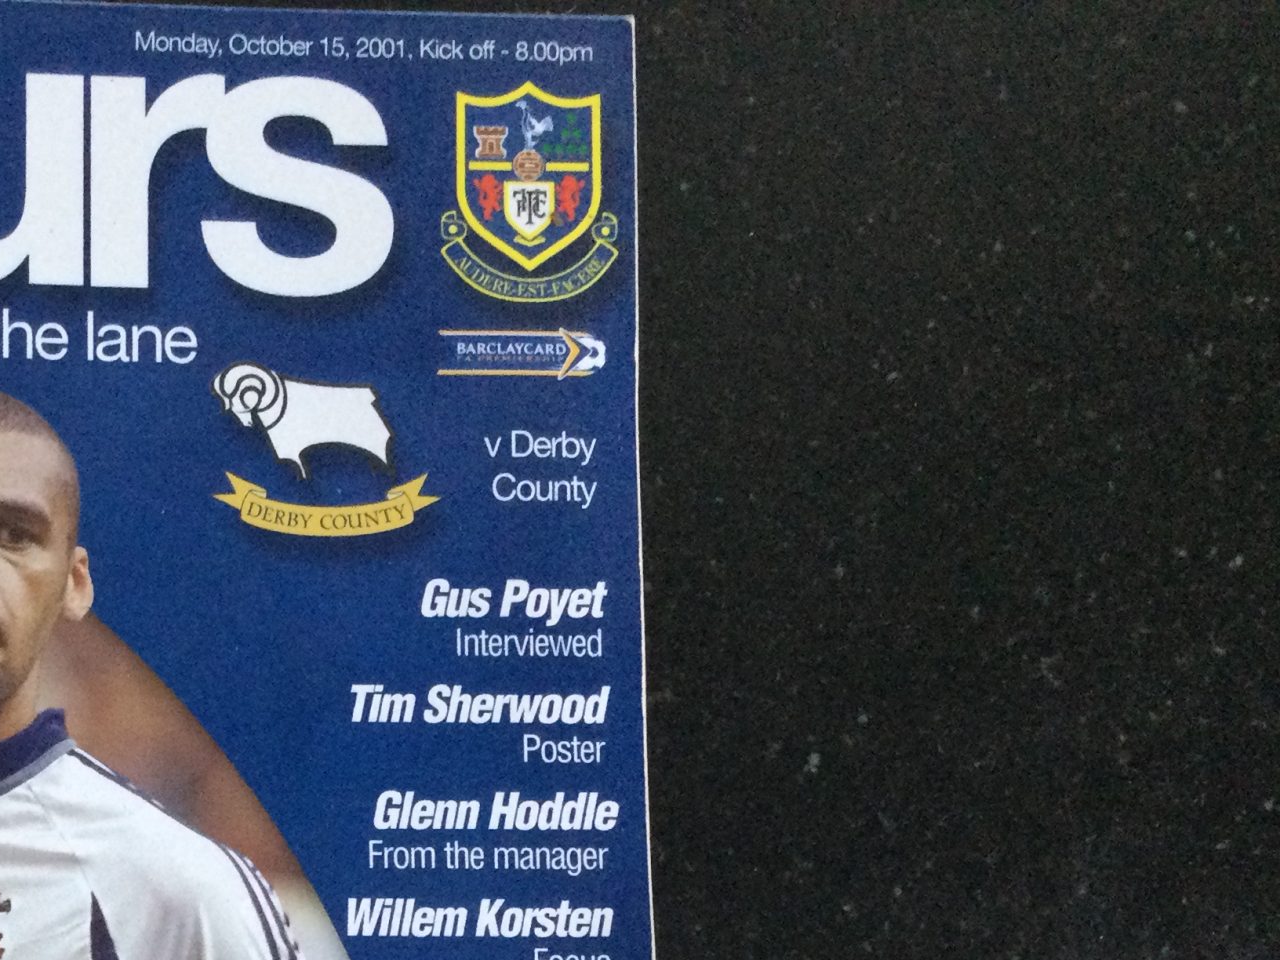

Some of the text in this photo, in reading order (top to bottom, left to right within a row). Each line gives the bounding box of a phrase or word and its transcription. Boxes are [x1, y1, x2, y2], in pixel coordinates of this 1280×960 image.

[135, 30, 222, 58] Monday,
[229, 33, 313, 56] October
[320, 37, 350, 60] 15,
[420, 39, 463, 60] Kick
[469, 40, 496, 60] off
[515, 41, 594, 66] 8.00pm
[86, 311, 198, 364] lane
[457, 342, 567, 355] BARCLAYCARD
[484, 430, 596, 465] v Derby
[492, 473, 597, 509] County
[246, 501, 405, 530] DERBY COUNTY
[421, 578, 608, 626] Gus Poyet
[456, 629, 602, 657] Interviewed
[350, 684, 611, 725] Tim Sherwood
[523, 734, 606, 763] Poster
[373, 790, 620, 832] Glenn Hoddle
[368, 840, 609, 876] From the manager
[347, 898, 614, 938] Willem Korsten
